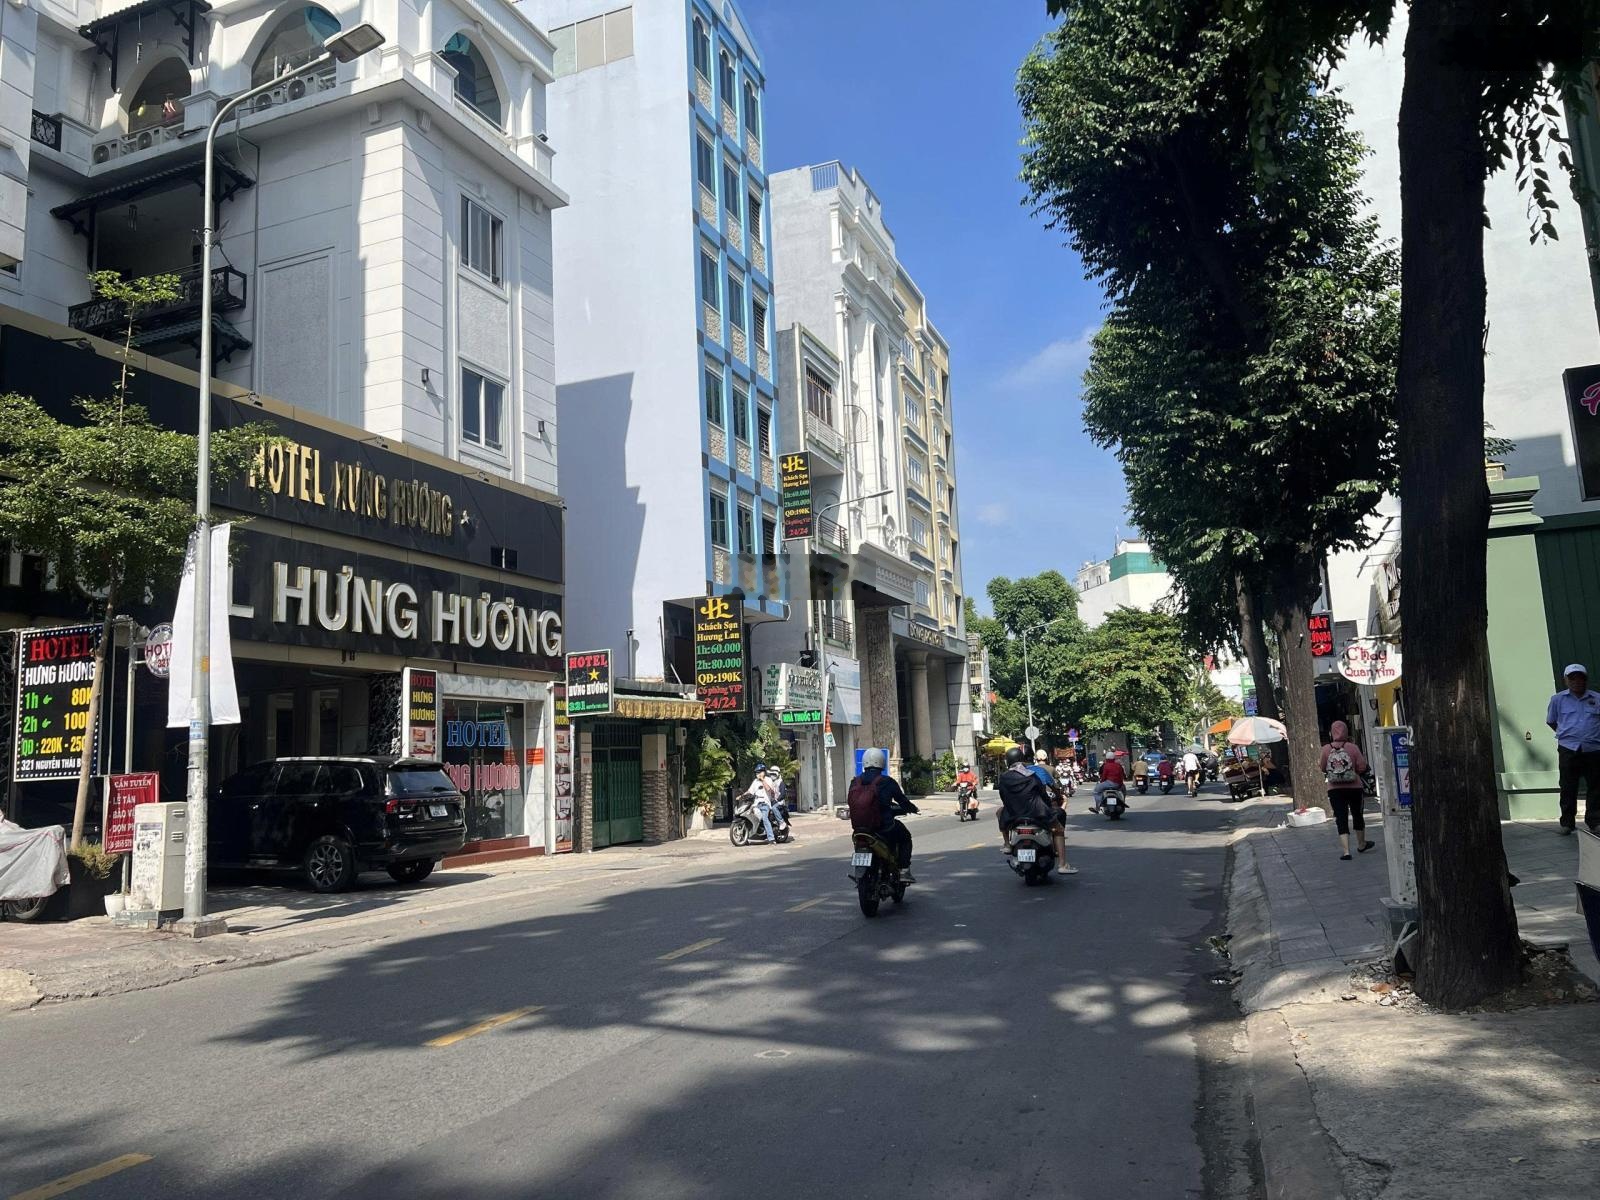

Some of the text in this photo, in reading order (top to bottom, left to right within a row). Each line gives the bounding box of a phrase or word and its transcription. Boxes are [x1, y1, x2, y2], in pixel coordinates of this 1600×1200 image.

[247, 440, 326, 505] HOTEL
[272, 561, 418, 640] HƯNG
[431, 590, 562, 657] HƯƠNG
[697, 621, 738, 632] Khách Sạn
[30, 635, 91, 662] HOTEL
[145, 642, 172, 656] HOT
[696, 642, 741, 655] 1h:60.000
[1347, 647, 1387, 663] Chay
[569, 654, 608, 669] HOTEL
[697, 657, 742, 670] 2h:80.000
[25, 661, 96, 686] HƯNG HƯƠNG
[698, 672, 742, 685] QĐ:190K
[1344, 668, 1373, 677] Quan
[411, 674, 434, 688] HOTEL
[729, 684, 742, 693] VIP
[24, 692, 39, 710] 1h
[412, 690, 434, 703] HƯNG
[704, 696, 737, 709] 24/24
[410, 708, 436, 721] HƯƠNG
[23, 716, 38, 733] 2h
[446, 720, 511, 747] HOTEL
[40, 737, 63, 754] 220K
[21, 759, 34, 771] 321
[475, 762, 520, 791] HƯƠNG
